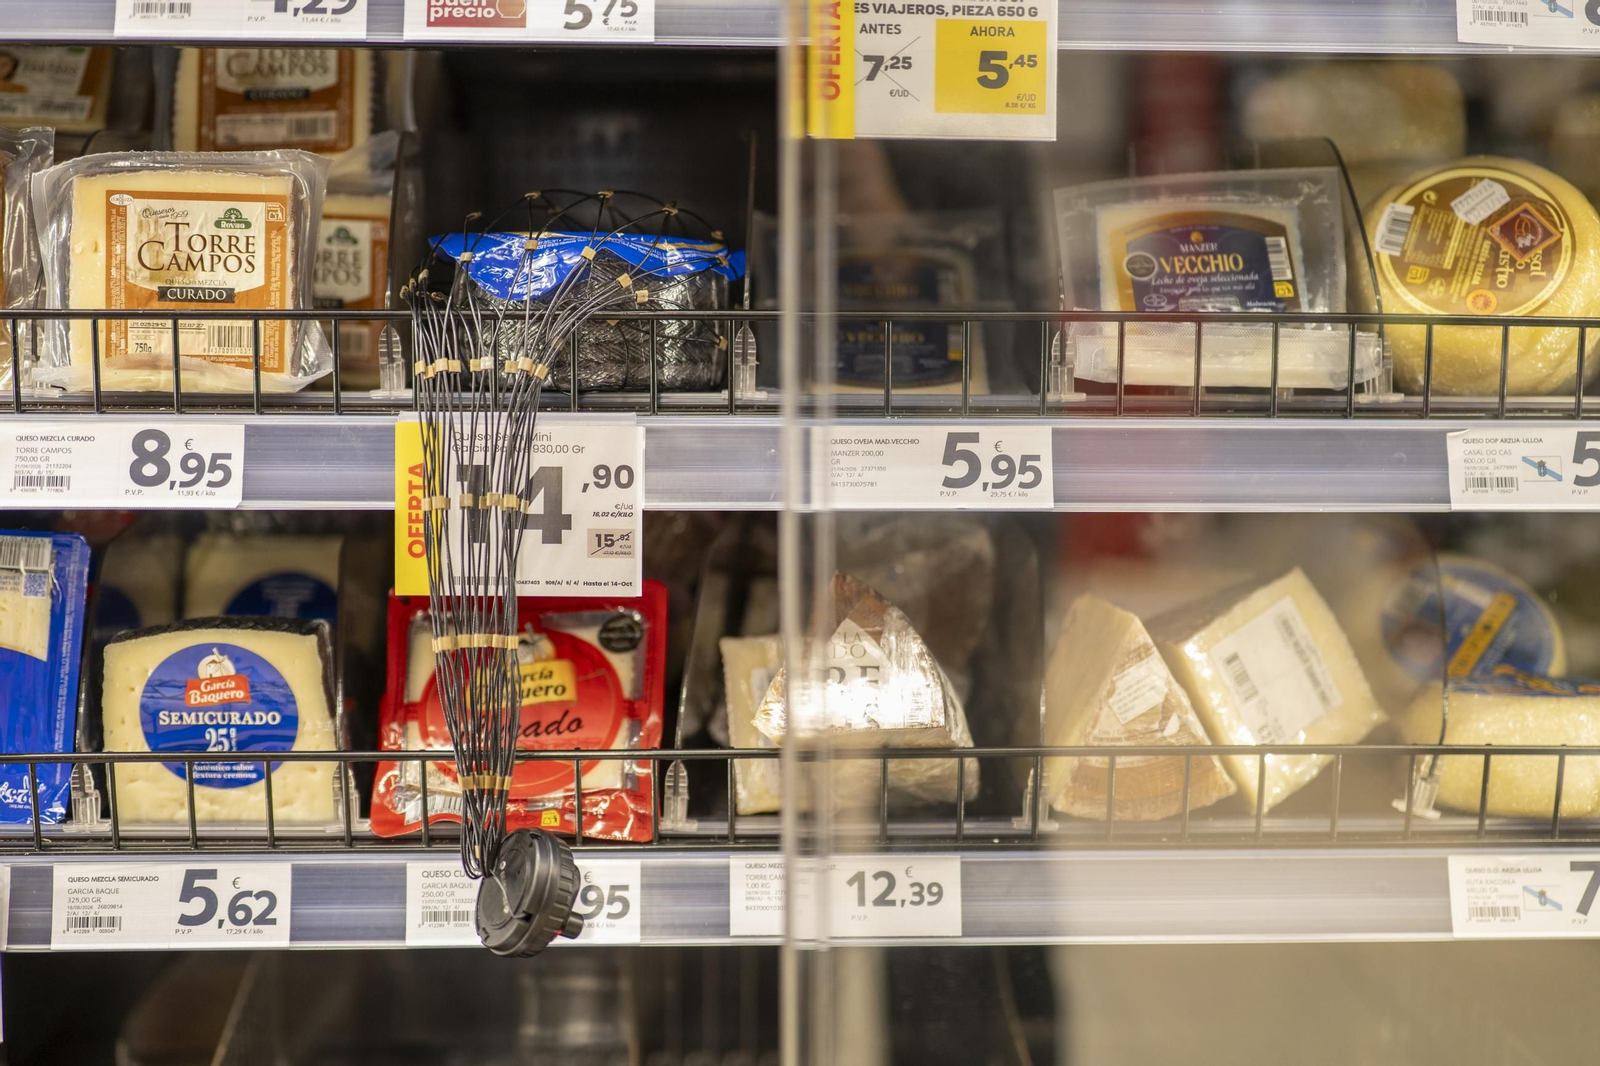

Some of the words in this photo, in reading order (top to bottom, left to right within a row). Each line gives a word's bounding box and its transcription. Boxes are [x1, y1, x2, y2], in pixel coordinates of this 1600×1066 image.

[430, 5, 495, 21] precio
[873, 3, 949, 16] VIAJEROS,
[952, 5, 995, 16] PIEZA
[997, 6, 1026, 17] 650
[1028, 7, 1038, 17] G
[602, 18, 610, 26] €
[859, 24, 902, 35] ANTES
[969, 26, 1015, 37] AHORA
[820, 2, 842, 101] OFERTA
[862, 55, 913, 81] 7,25
[976, 51, 1038, 89] 5,45
[1016, 93, 1036, 101] €/UD
[164, 221, 256, 254] TORRE
[1179, 243, 1218, 253] MANZER
[137, 240, 256, 274] CAMPOS
[1160, 253, 1244, 274] VECCHIO
[1529, 249, 1547, 277] sal
[1495, 245, 1514, 288] astro
[165, 278, 192, 286] QUESO
[318, 268, 361, 286] POS
[1176, 274, 1185, 284] de
[1188, 273, 1208, 287] oveja
[1210, 271, 1259, 283] seleccionada
[167, 288, 227, 300] CURADO
[184, 438, 193, 451] €
[533, 444, 569, 455] 930,00
[572, 445, 586, 454] Gr
[994, 440, 1003, 452] €
[129, 428, 232, 490] 8,95
[941, 432, 1043, 492] 5,95
[1464, 457, 1485, 465] 600,00
[1572, 431, 1600, 487] 5
[407, 462, 427, 559] OFERTA
[615, 502, 633, 510] €/Ud
[830, 632, 862, 644] CLA
[832, 644, 867, 659] DO
[200, 679, 236, 693] García
[189, 690, 245, 704] Baquero
[159, 711, 282, 725] SEMICURADO
[421, 870, 451, 878] QUESO
[453, 870, 466, 878] CU
[583, 871, 592, 883] €
[905, 866, 913, 878] €
[232, 877, 241, 889] €
[846, 870, 943, 907] 12,39
[1570, 861, 1600, 916] 7
[177, 868, 278, 929] 5,62
[580, 884, 630, 920] 95
